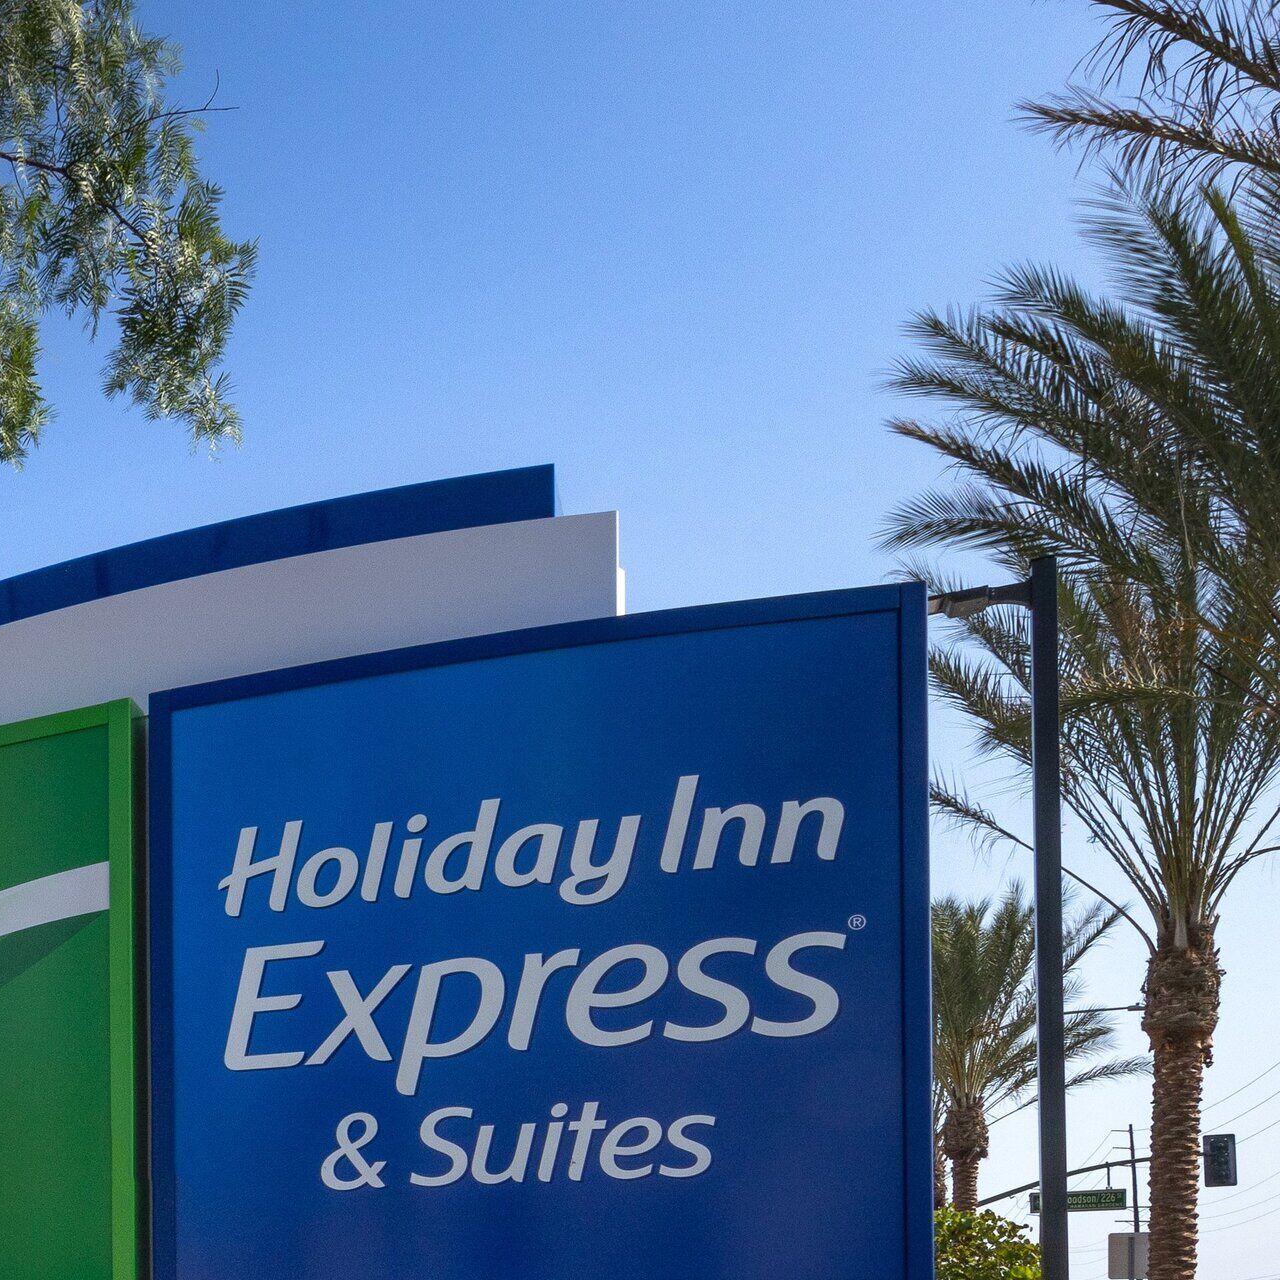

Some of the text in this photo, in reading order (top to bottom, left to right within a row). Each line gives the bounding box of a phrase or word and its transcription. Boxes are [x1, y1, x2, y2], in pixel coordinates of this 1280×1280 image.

[217, 773, 846, 918] Holiday Inn
[223, 931, 848, 1096] Express
[319, 1101, 716, 1192] & Suites
